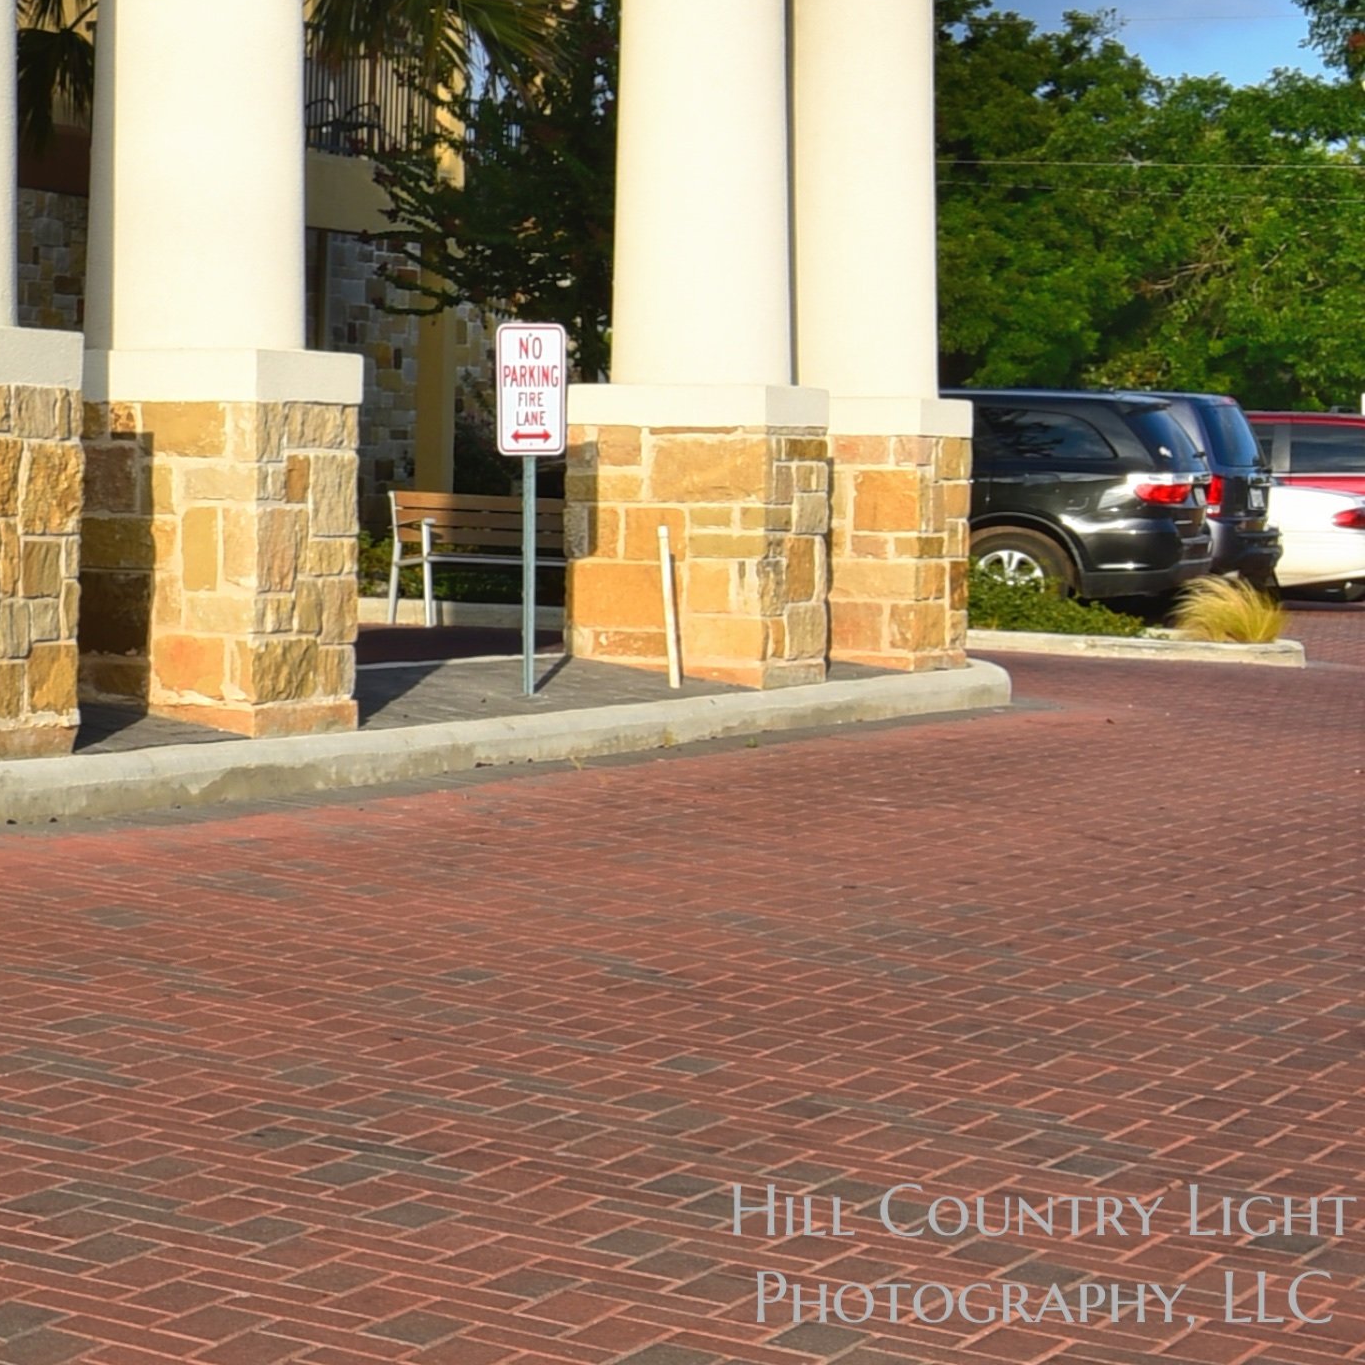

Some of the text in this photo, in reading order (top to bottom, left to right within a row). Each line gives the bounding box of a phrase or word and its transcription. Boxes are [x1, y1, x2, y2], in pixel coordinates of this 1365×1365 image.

[519, 337, 543, 359] NO
[503, 365, 559, 388] PARKING
[518, 392, 544, 407] FIRE
[516, 411, 546, 426] LANE
